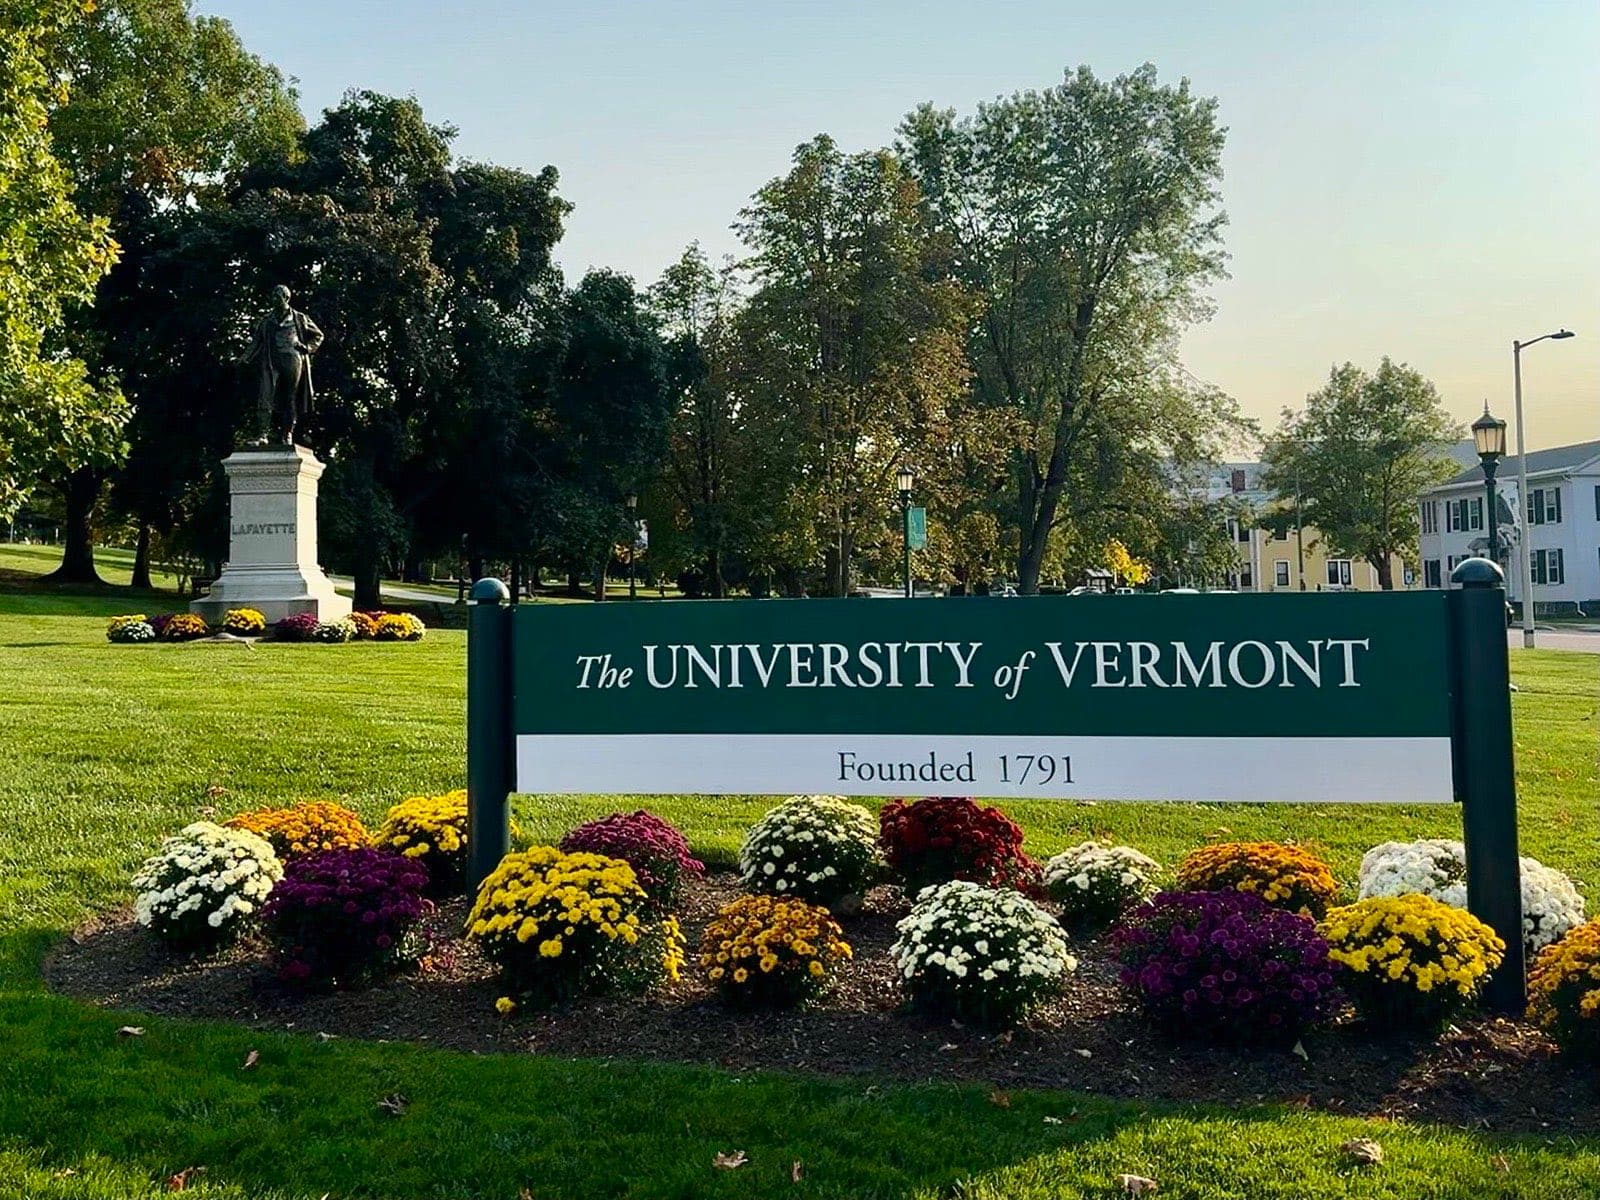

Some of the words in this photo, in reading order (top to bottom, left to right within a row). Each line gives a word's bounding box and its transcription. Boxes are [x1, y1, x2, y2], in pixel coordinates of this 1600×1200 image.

[232, 523, 296, 535] LAFAYETTE
[576, 653, 634, 689] The
[642, 641, 983, 689] UNIVERSITY
[994, 650, 1036, 700] of
[1044, 638, 1370, 688] VERMONT
[837, 750, 977, 783] Founded
[998, 754, 1075, 786] 1791
